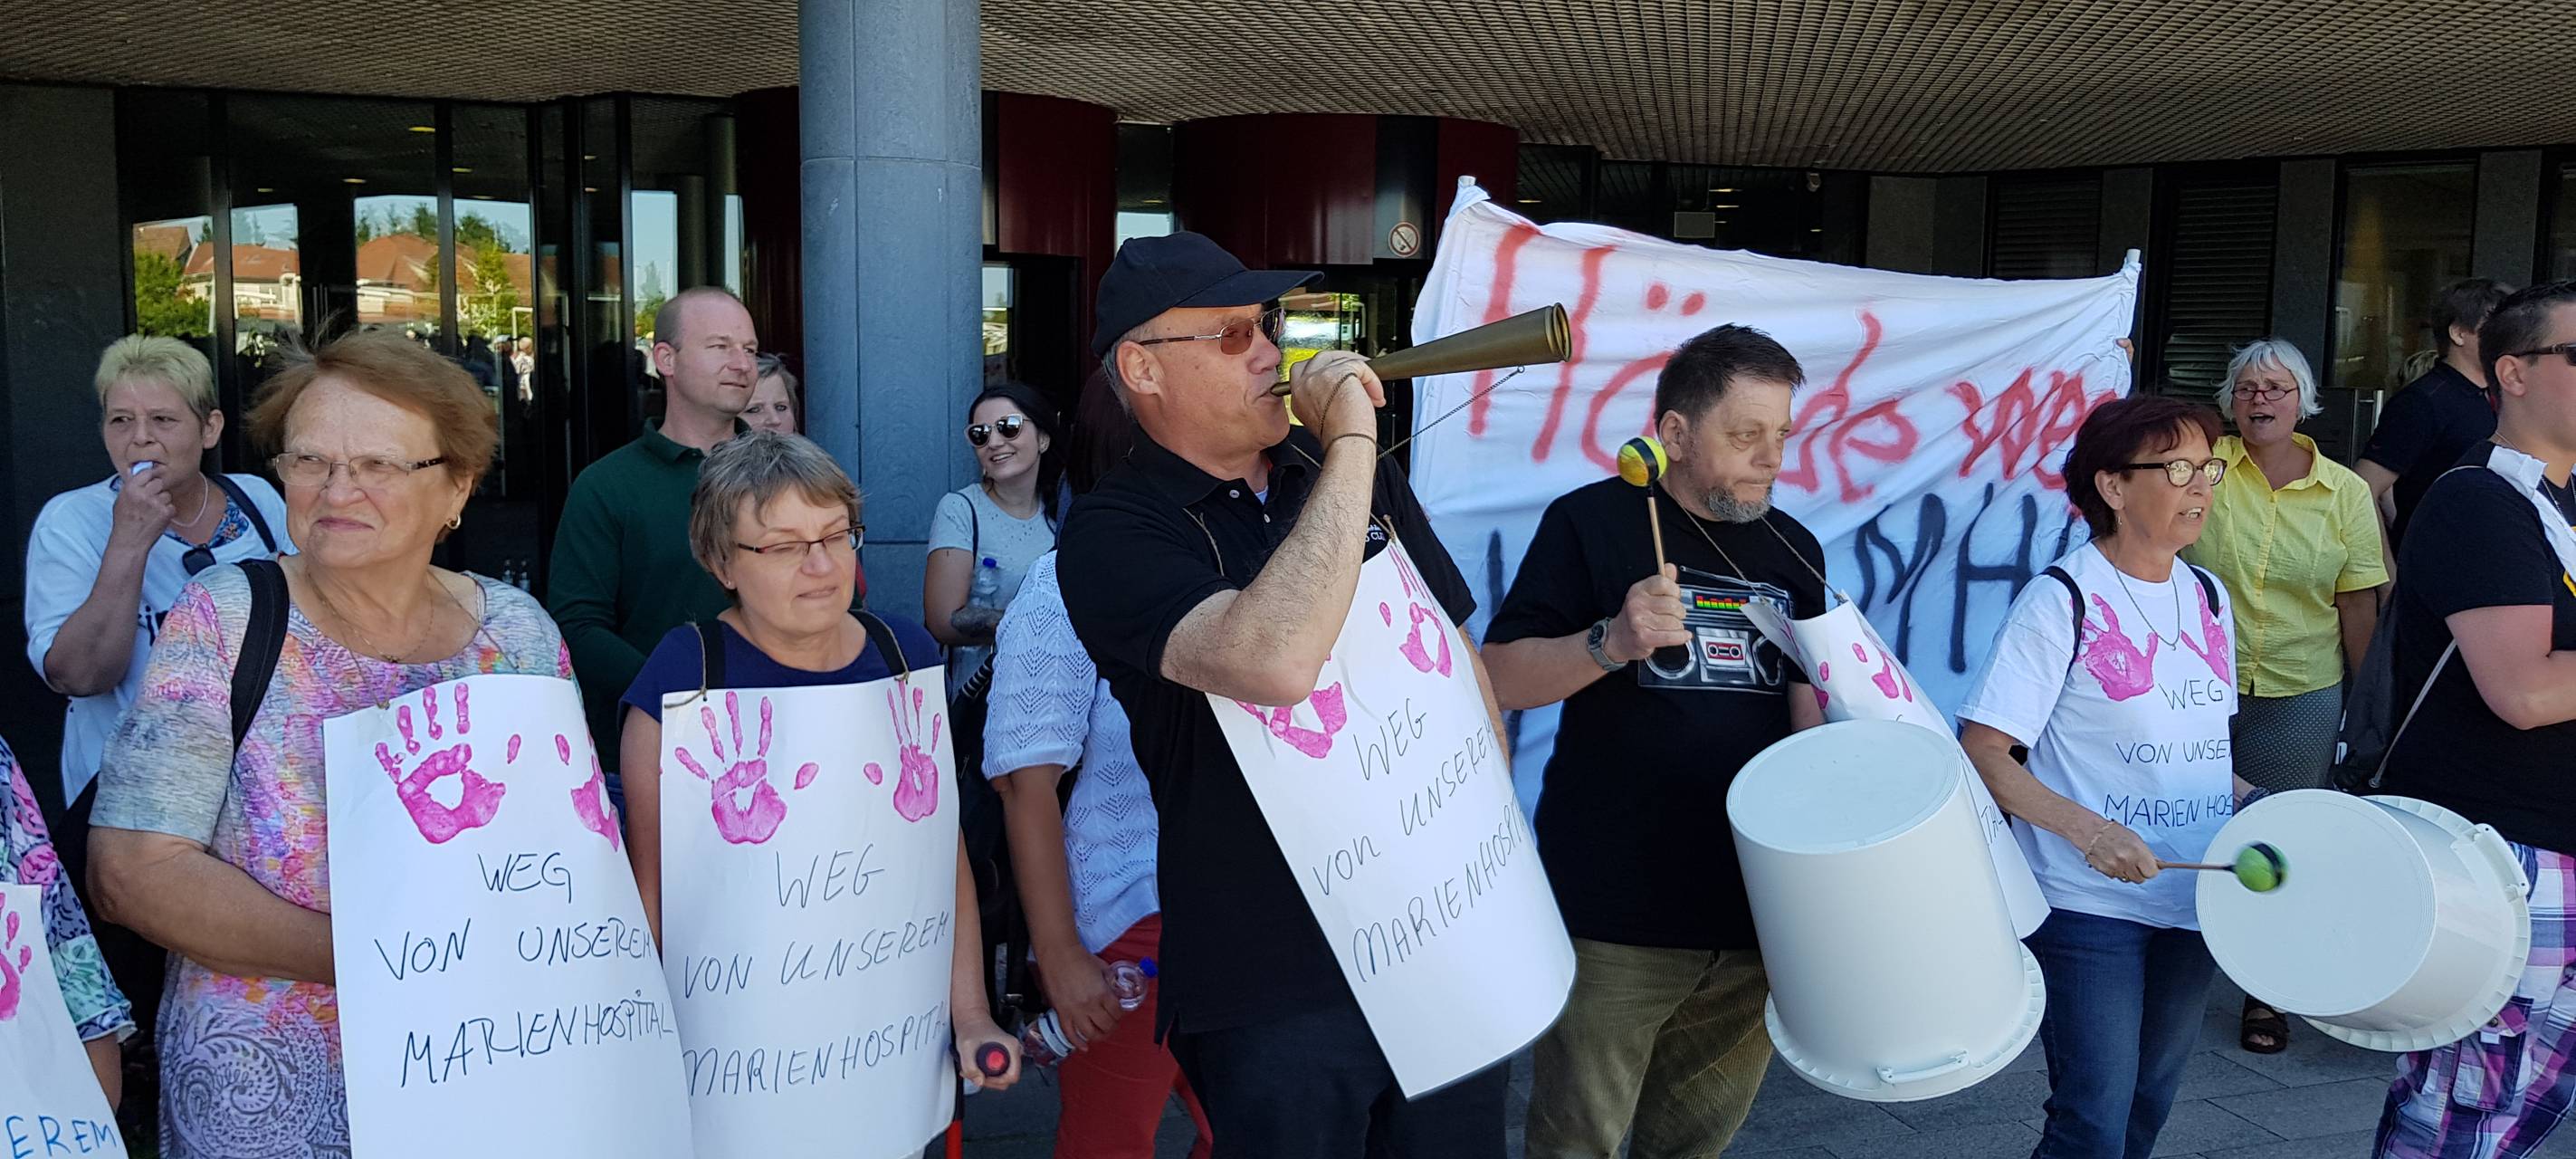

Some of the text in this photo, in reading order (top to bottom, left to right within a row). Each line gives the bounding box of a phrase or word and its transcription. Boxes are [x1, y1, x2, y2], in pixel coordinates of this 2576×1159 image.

[2158, 678, 2224, 711] WEG
[1352, 697, 1427, 781] WEG
[2115, 741, 2173, 764] VON
[477, 851, 572, 904] WEG
[776, 843, 886, 909] WEG
[373, 917, 472, 981] VON
[685, 953, 753, 999] VON
